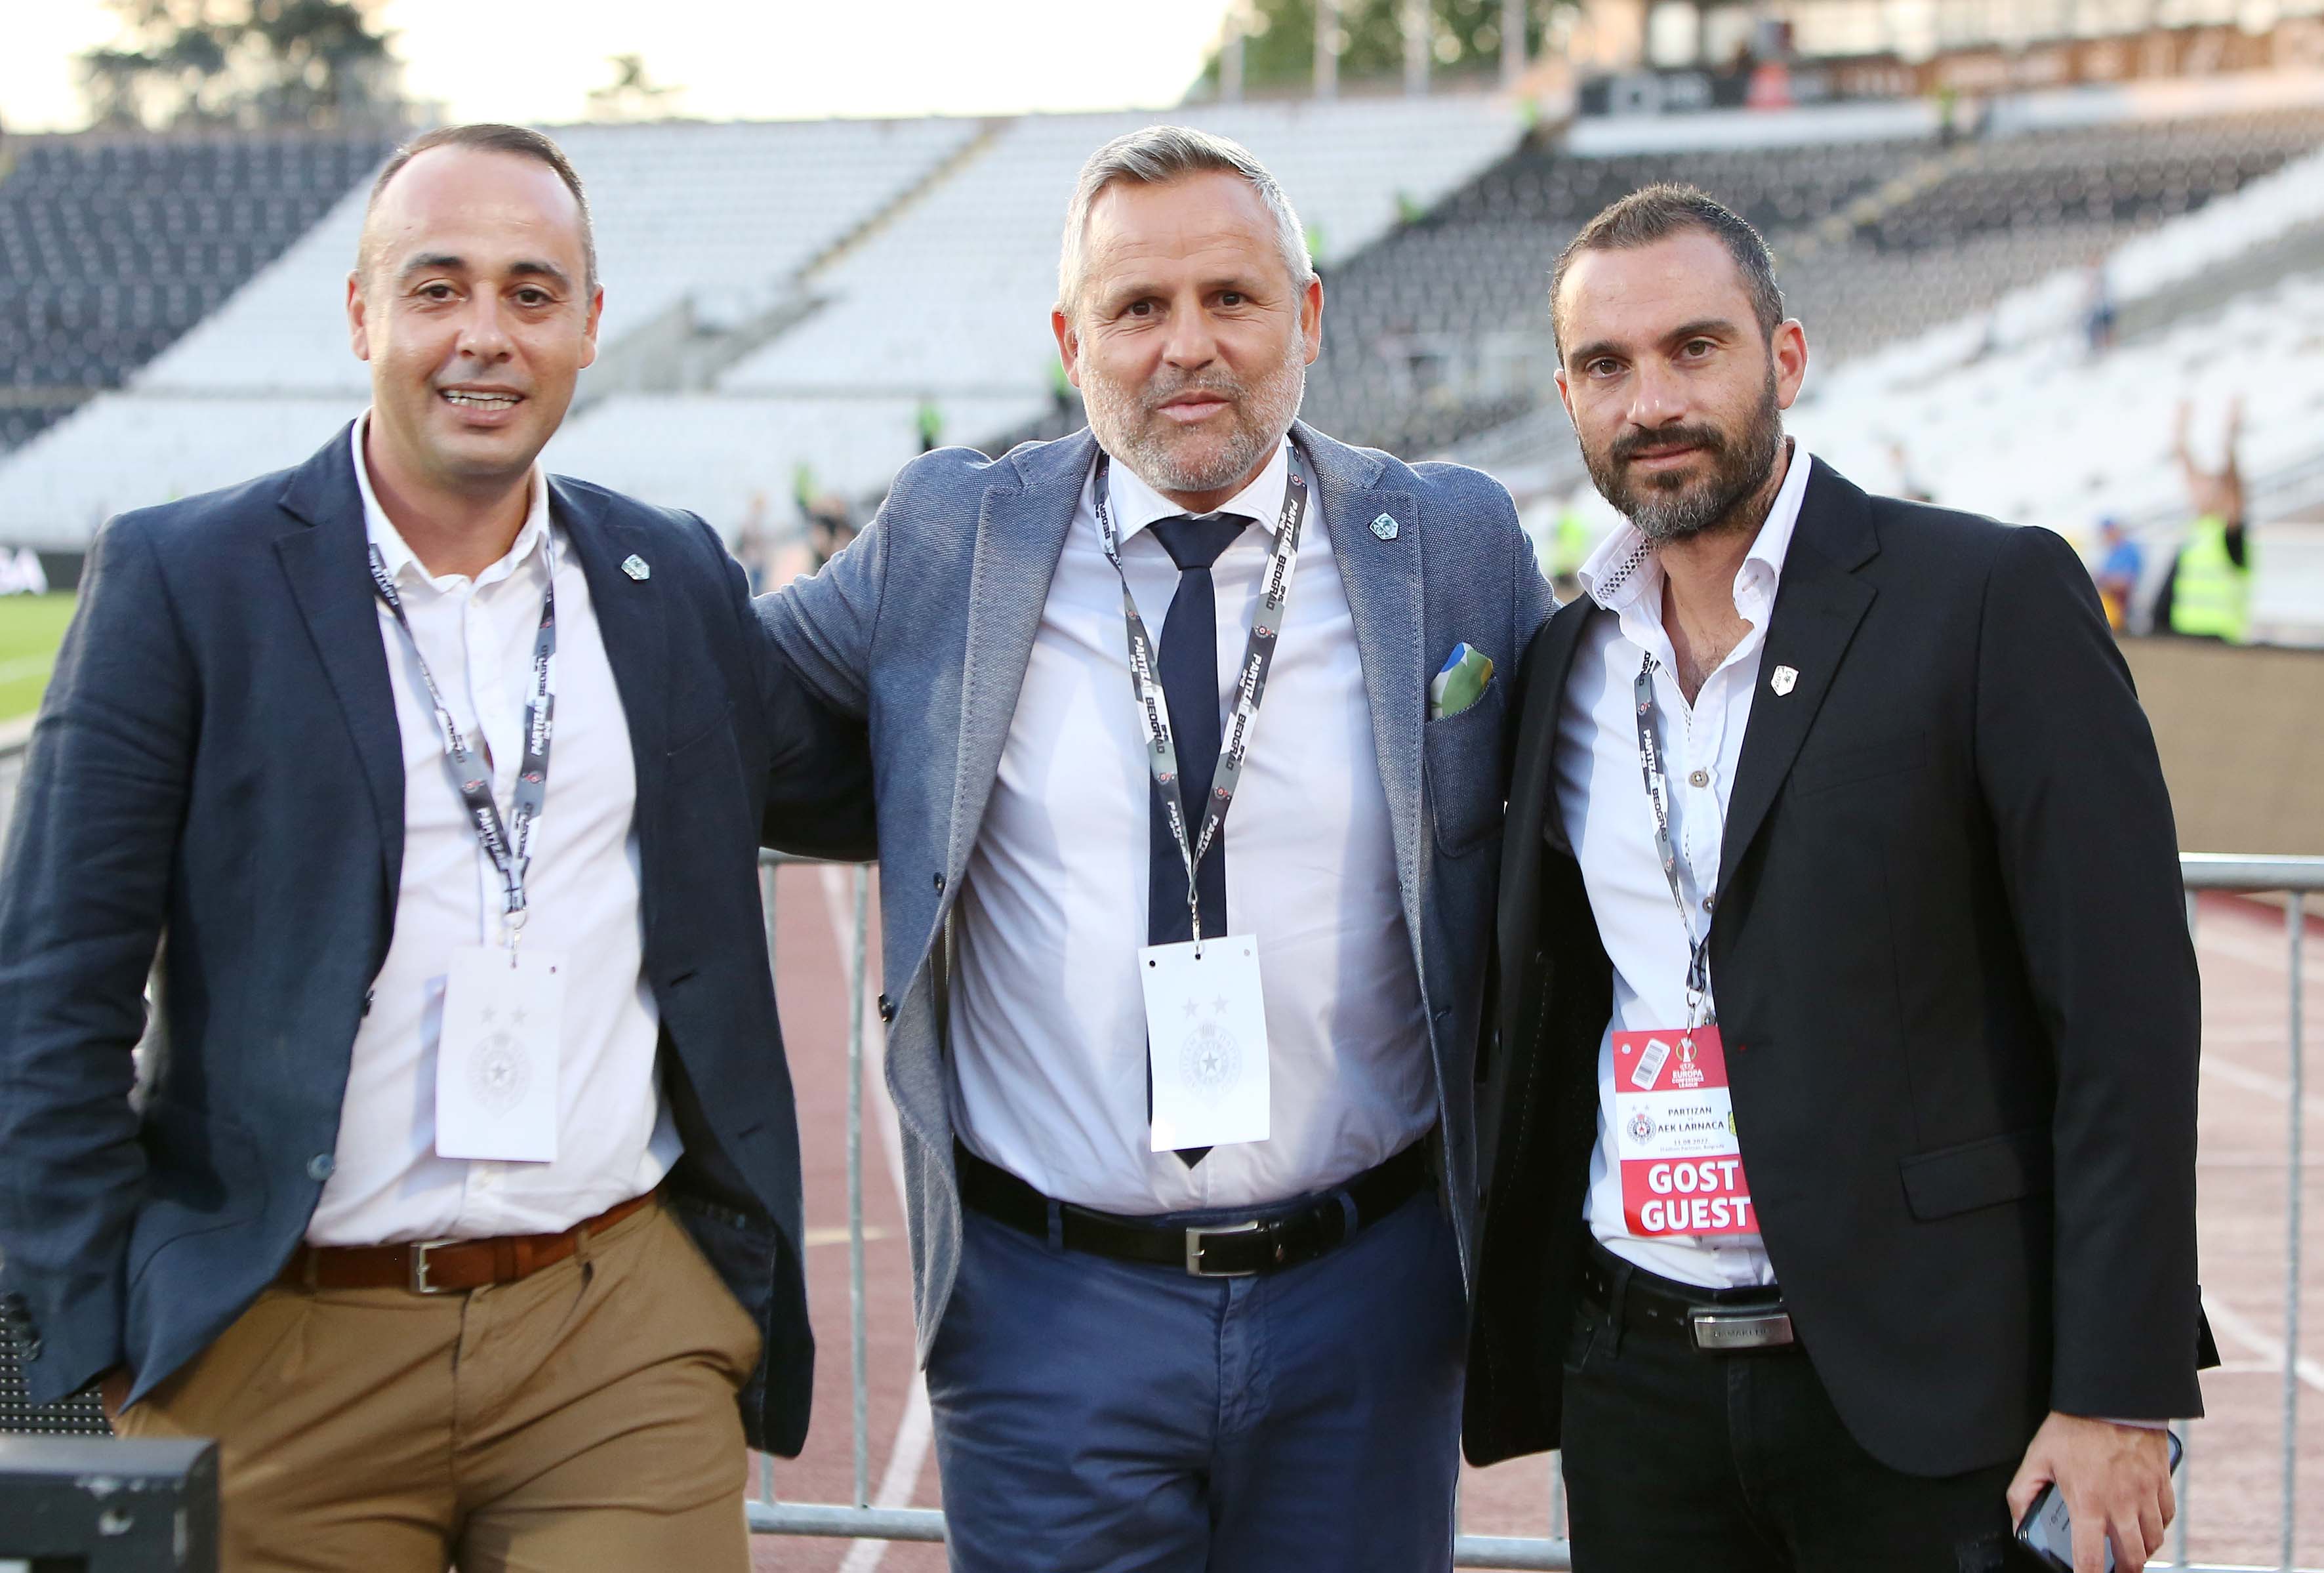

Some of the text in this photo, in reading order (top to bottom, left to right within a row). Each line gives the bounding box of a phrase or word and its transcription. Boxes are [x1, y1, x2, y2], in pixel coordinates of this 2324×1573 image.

[1278, 511, 1287, 531] 1945
[1266, 554, 1287, 611] BEOGRAD
[1145, 697, 1165, 754] BEOGRAD
[1225, 714, 1246, 771] BEOGRAD
[1652, 788, 1667, 842] BEOGRAD
[1672, 1069, 1704, 1079] EUROPA
[1658, 1121, 1724, 1134] AEK LARNACA
[1668, 1107, 1712, 1116] PARTIZAN
[1648, 1160, 1740, 1195] GOST
[1640, 1196, 1751, 1233] GUEST
